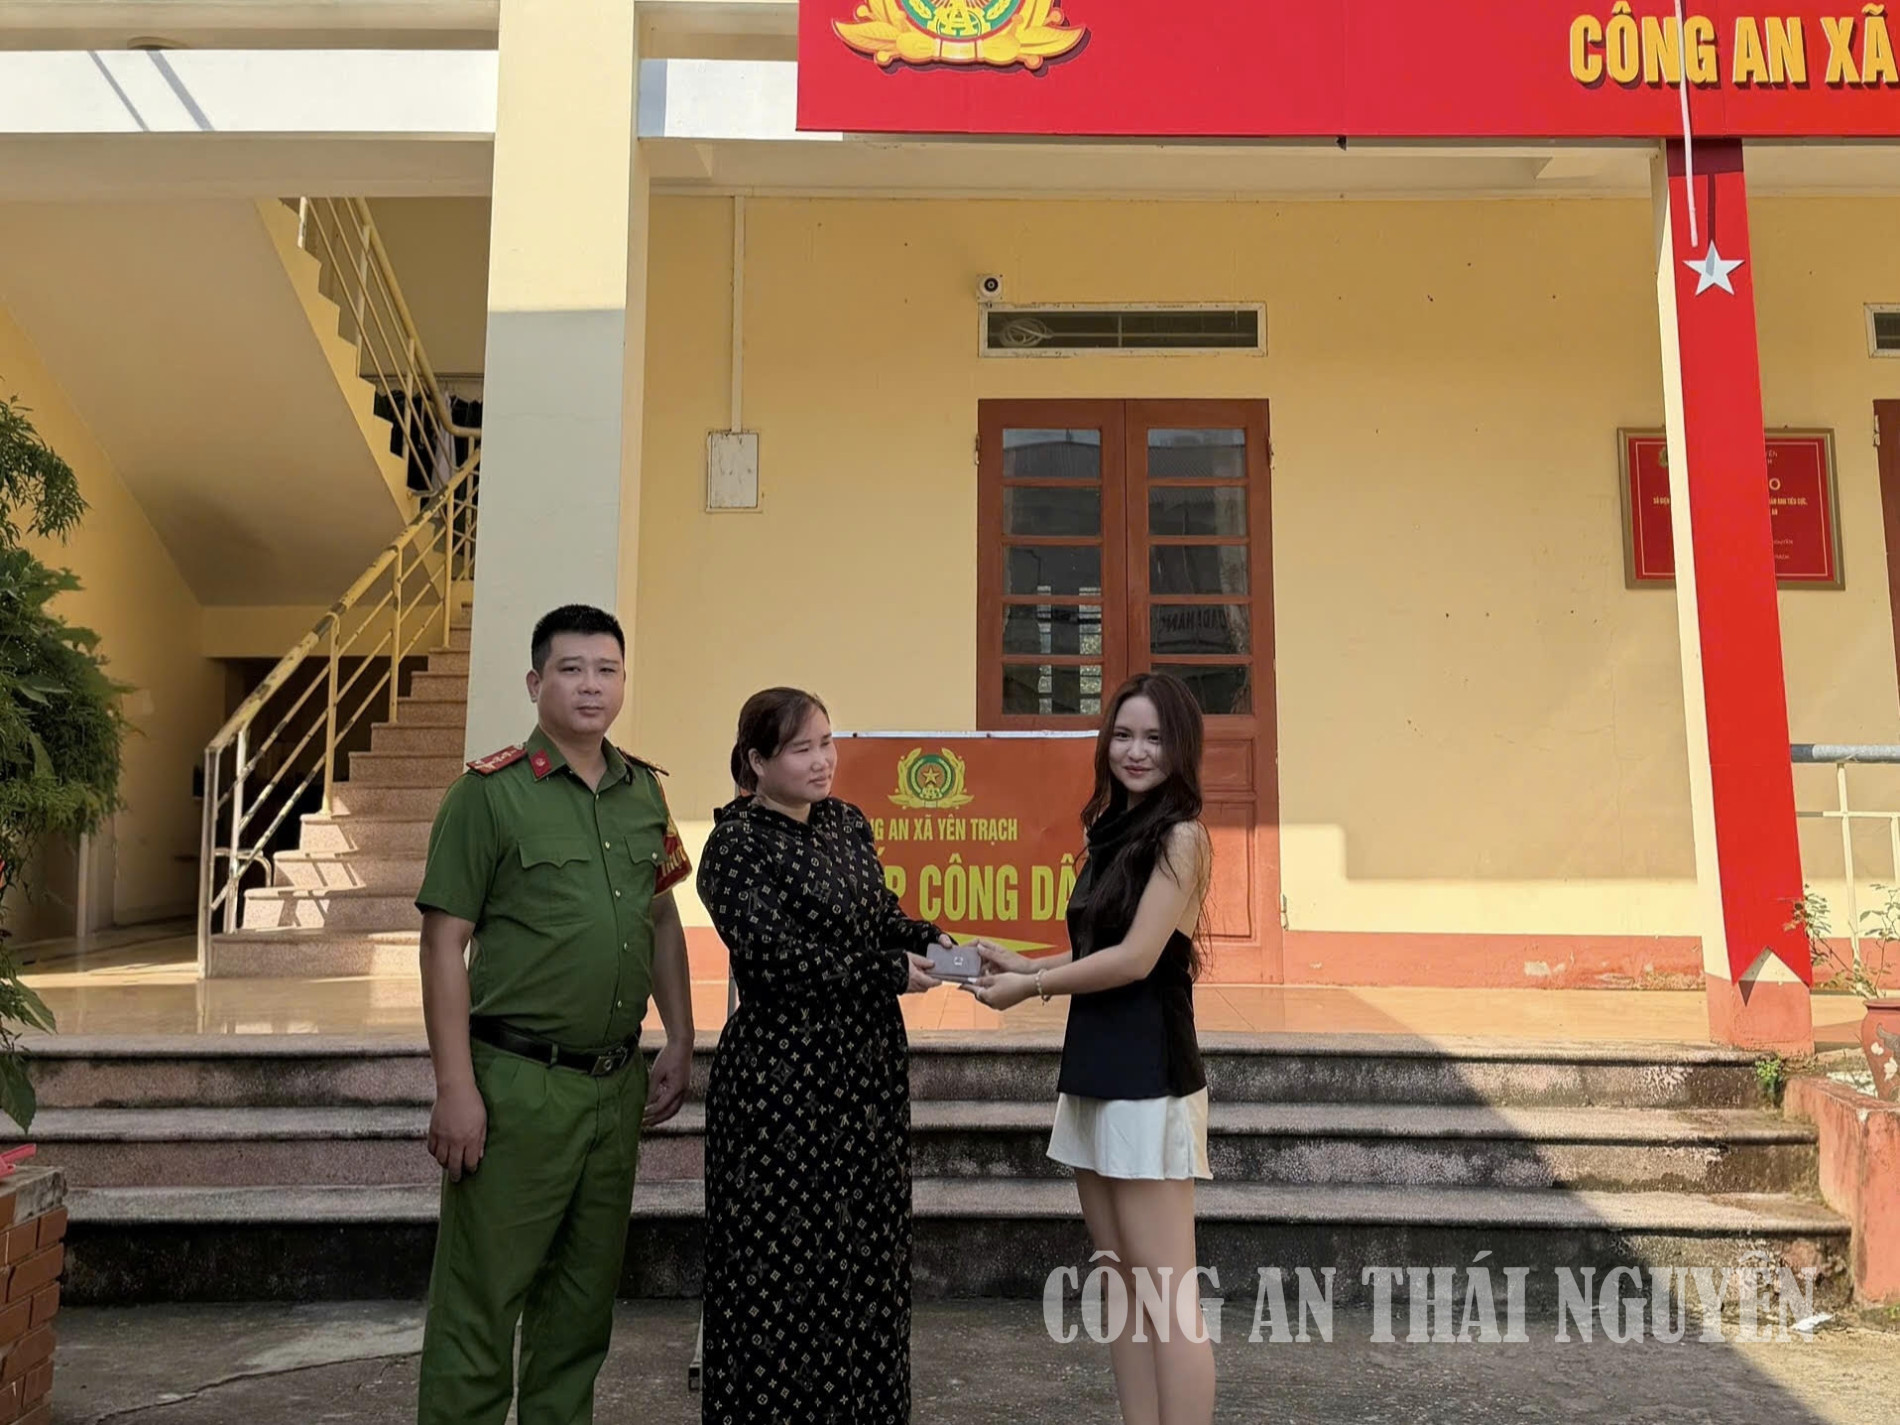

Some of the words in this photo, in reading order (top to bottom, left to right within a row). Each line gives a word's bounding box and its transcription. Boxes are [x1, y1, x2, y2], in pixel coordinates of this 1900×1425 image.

[1569, 1, 1718, 84] CÔNG
[1732, 16, 1807, 84] AN
[1820, 3, 1899, 84] XÃ
[888, 818, 909, 841] AN
[913, 814, 934, 841] XÃ
[937, 813, 966, 841] YÊN
[970, 818, 1018, 846] TRẠCH
[919, 853, 1018, 921] CÔNG
[1031, 853, 1077, 921] DÂ
